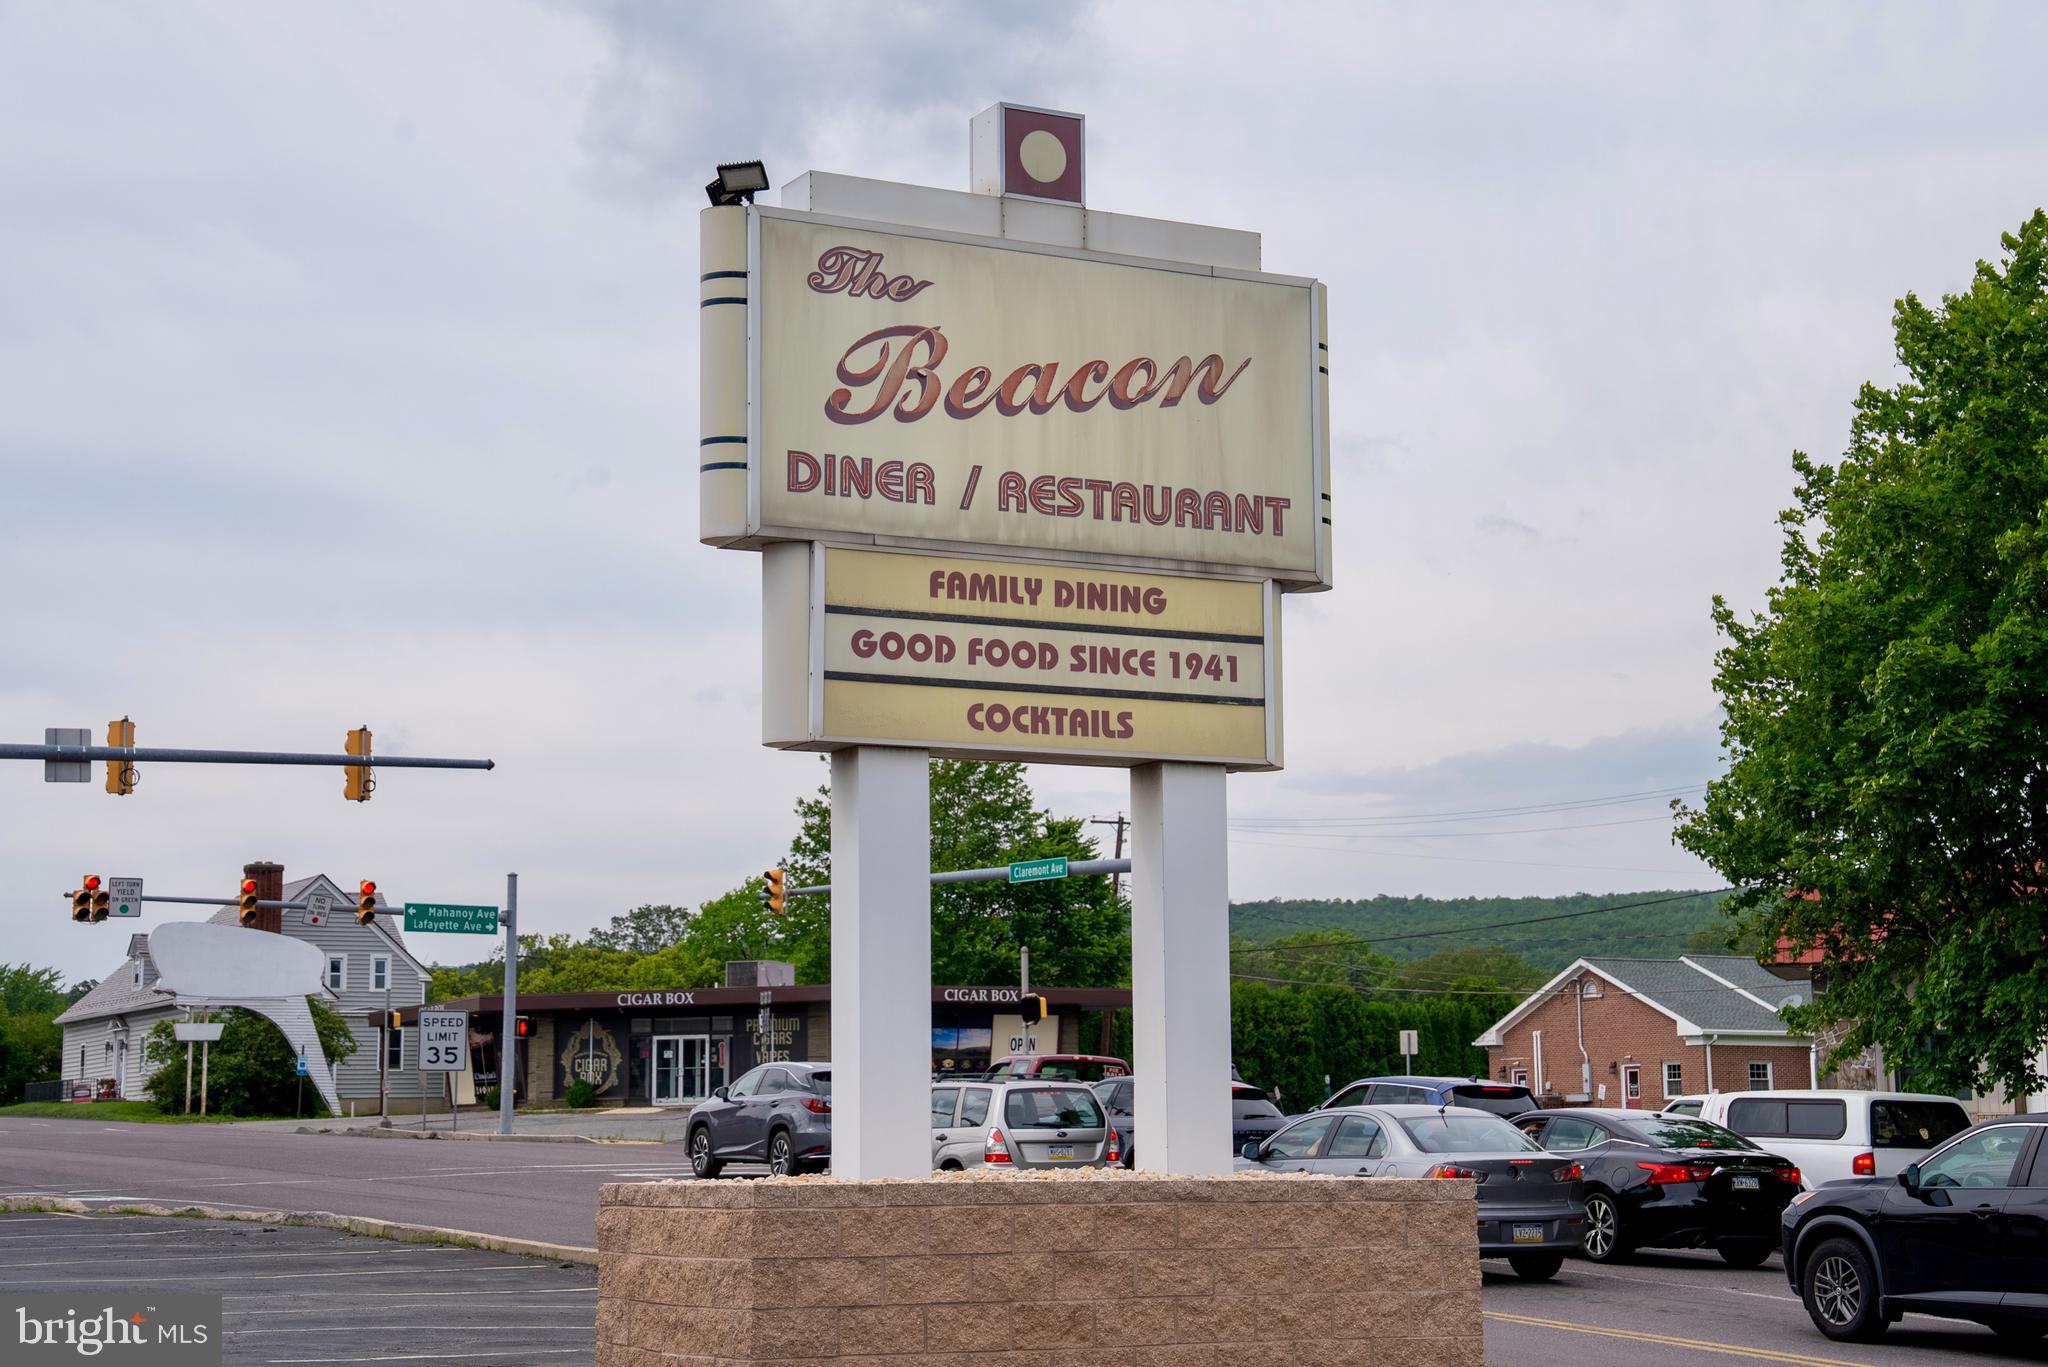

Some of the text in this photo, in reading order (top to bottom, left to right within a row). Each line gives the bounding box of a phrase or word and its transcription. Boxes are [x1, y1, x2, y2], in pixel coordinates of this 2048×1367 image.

[807, 246, 934, 302] The
[824, 325, 1252, 425] Beacon
[787, 450, 935, 505] DINER
[998, 471, 1290, 536] RESTAURANT
[930, 570, 1167, 615] FAMILY DINING
[851, 629, 1239, 683] GOOD FOOD SINCE 1941
[966, 703, 1134, 739] COCKTAILS
[1013, 862, 1063, 878] Claremont Ave
[117, 888, 135, 896] YIELD
[314, 896, 326, 904] NO
[428, 907, 496, 920] Mahanoy Ave
[413, 919, 482, 932] Lafayette Ave
[617, 992, 694, 1006] CIGAR BOX
[944, 989, 1019, 1002] CIGAR BOX
[423, 1017, 464, 1027] SPEED
[745, 1017, 800, 1032] PRMIUM
[427, 1032, 459, 1042] LIMIT
[1010, 1037, 1036, 1051] OPN
[426, 1046, 458, 1064] 35
[575, 1058, 608, 1072] CIGAR
